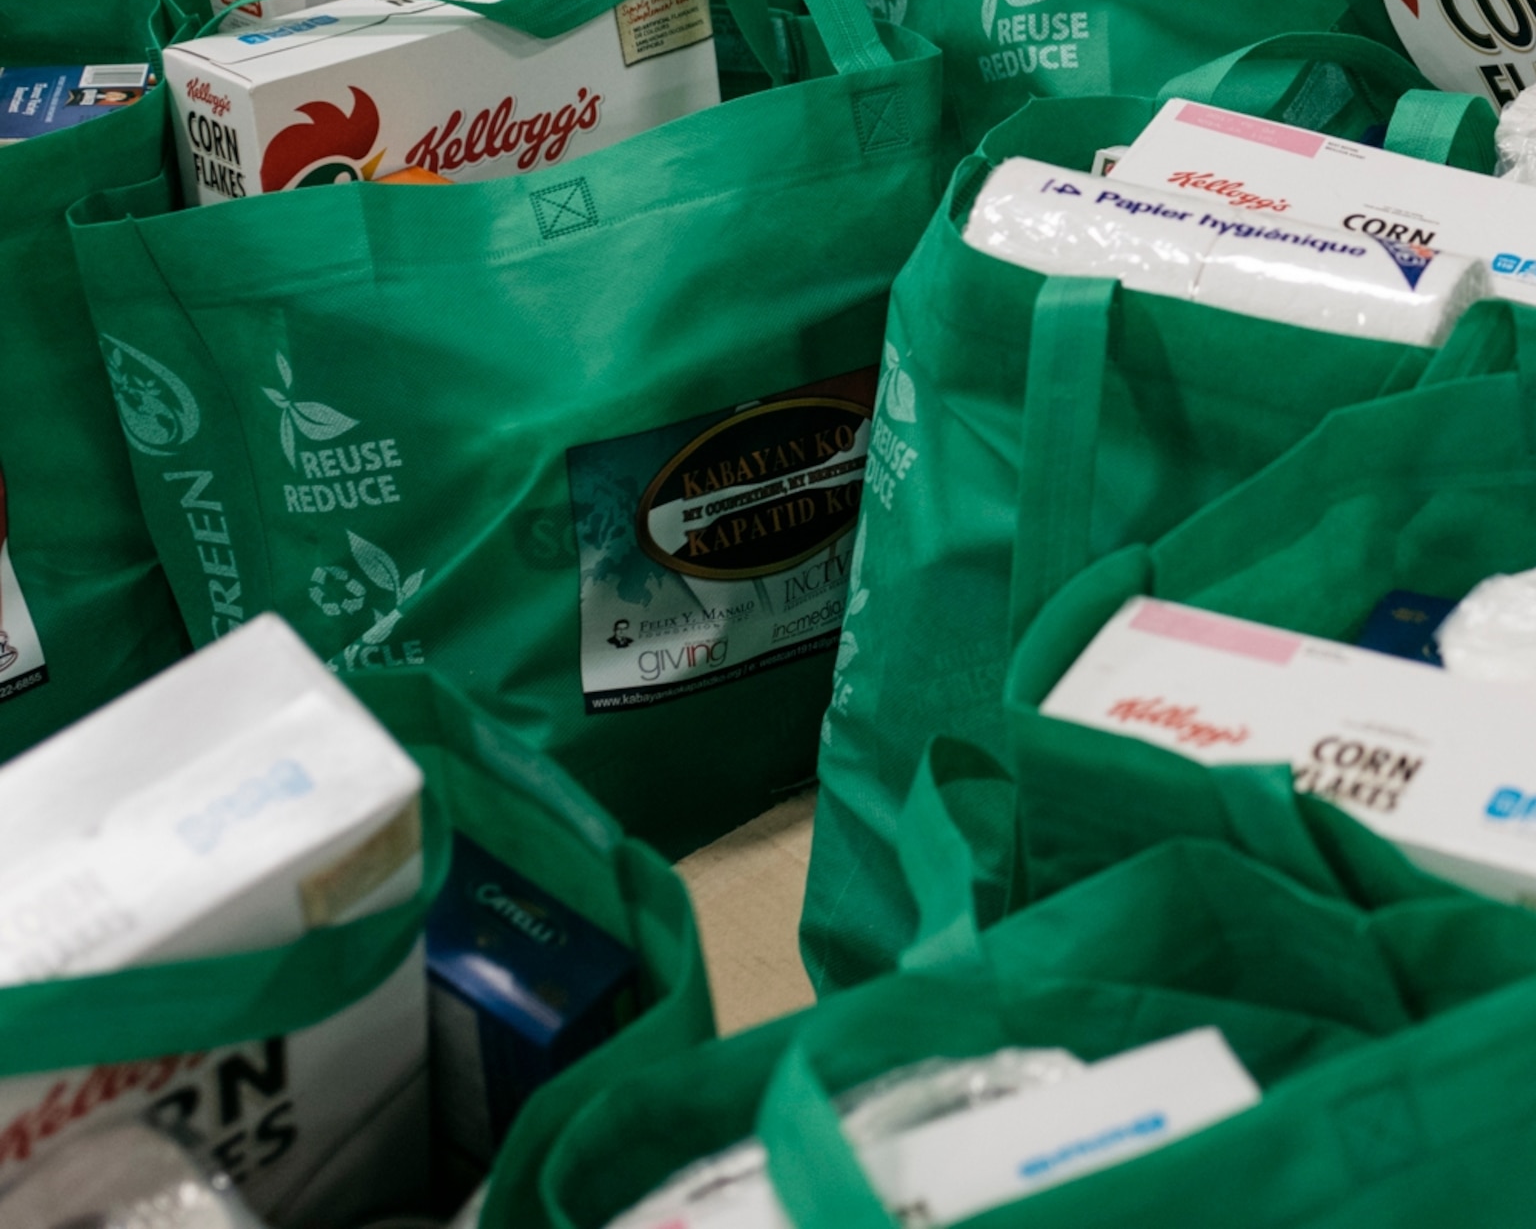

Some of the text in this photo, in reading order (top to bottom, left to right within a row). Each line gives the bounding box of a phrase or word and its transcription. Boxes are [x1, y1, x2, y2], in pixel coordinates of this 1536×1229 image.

[997, 12, 1089, 44] REUSE
[978, 43, 1079, 84] REDUCE
[186, 78, 231, 112] Kellogg's
[187, 111, 240, 164] CORN
[405, 87, 603, 174] Kellogg's
[194, 157, 247, 199] FLAKES
[1167, 171, 1291, 213] Kellogg's
[1096, 188, 1368, 261] Papier hygiénique
[1344, 213, 1436, 247] CORN
[301, 439, 402, 478] REUSE
[682, 438, 806, 500] KABAYAN
[815, 424, 856, 458] KO
[872, 416, 918, 469] REUSE
[284, 475, 400, 513] REDUCE
[865, 454, 896, 512] DUCE
[686, 496, 816, 557] KAPATID
[164, 471, 245, 642] GREEN
[783, 556, 849, 605] INCTV
[639, 616, 677, 633] FELIX
[701, 599, 755, 621] MANALO
[772, 599, 845, 640] incmedia.
[638, 638, 729, 682] giving
[0, 672, 44, 700] 22-6855
[1107, 696, 1250, 748] Kellogg's
[1310, 735, 1426, 783] CORN
